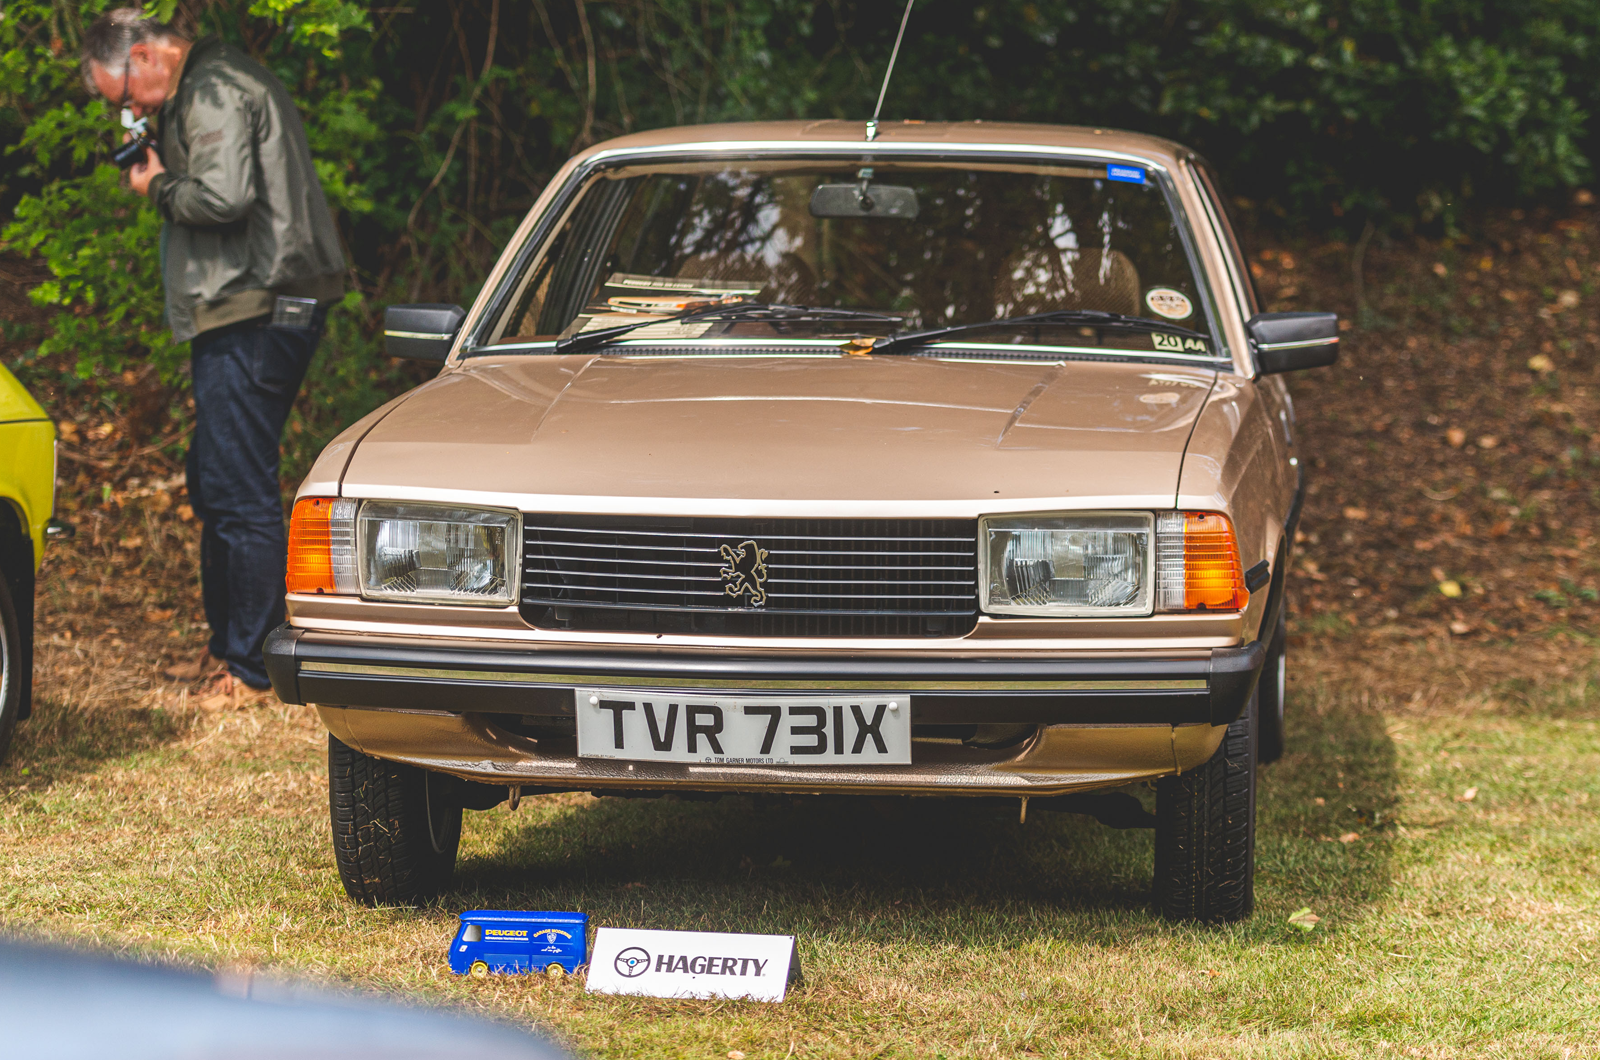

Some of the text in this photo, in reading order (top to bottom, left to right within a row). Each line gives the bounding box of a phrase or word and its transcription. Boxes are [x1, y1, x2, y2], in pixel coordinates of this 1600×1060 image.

[1155, 333, 1206, 352] 20 AA
[599, 700, 889, 755] TVR 731X
[485, 929, 528, 937] PEUGEOT
[655, 955, 768, 976] HAGERTY
